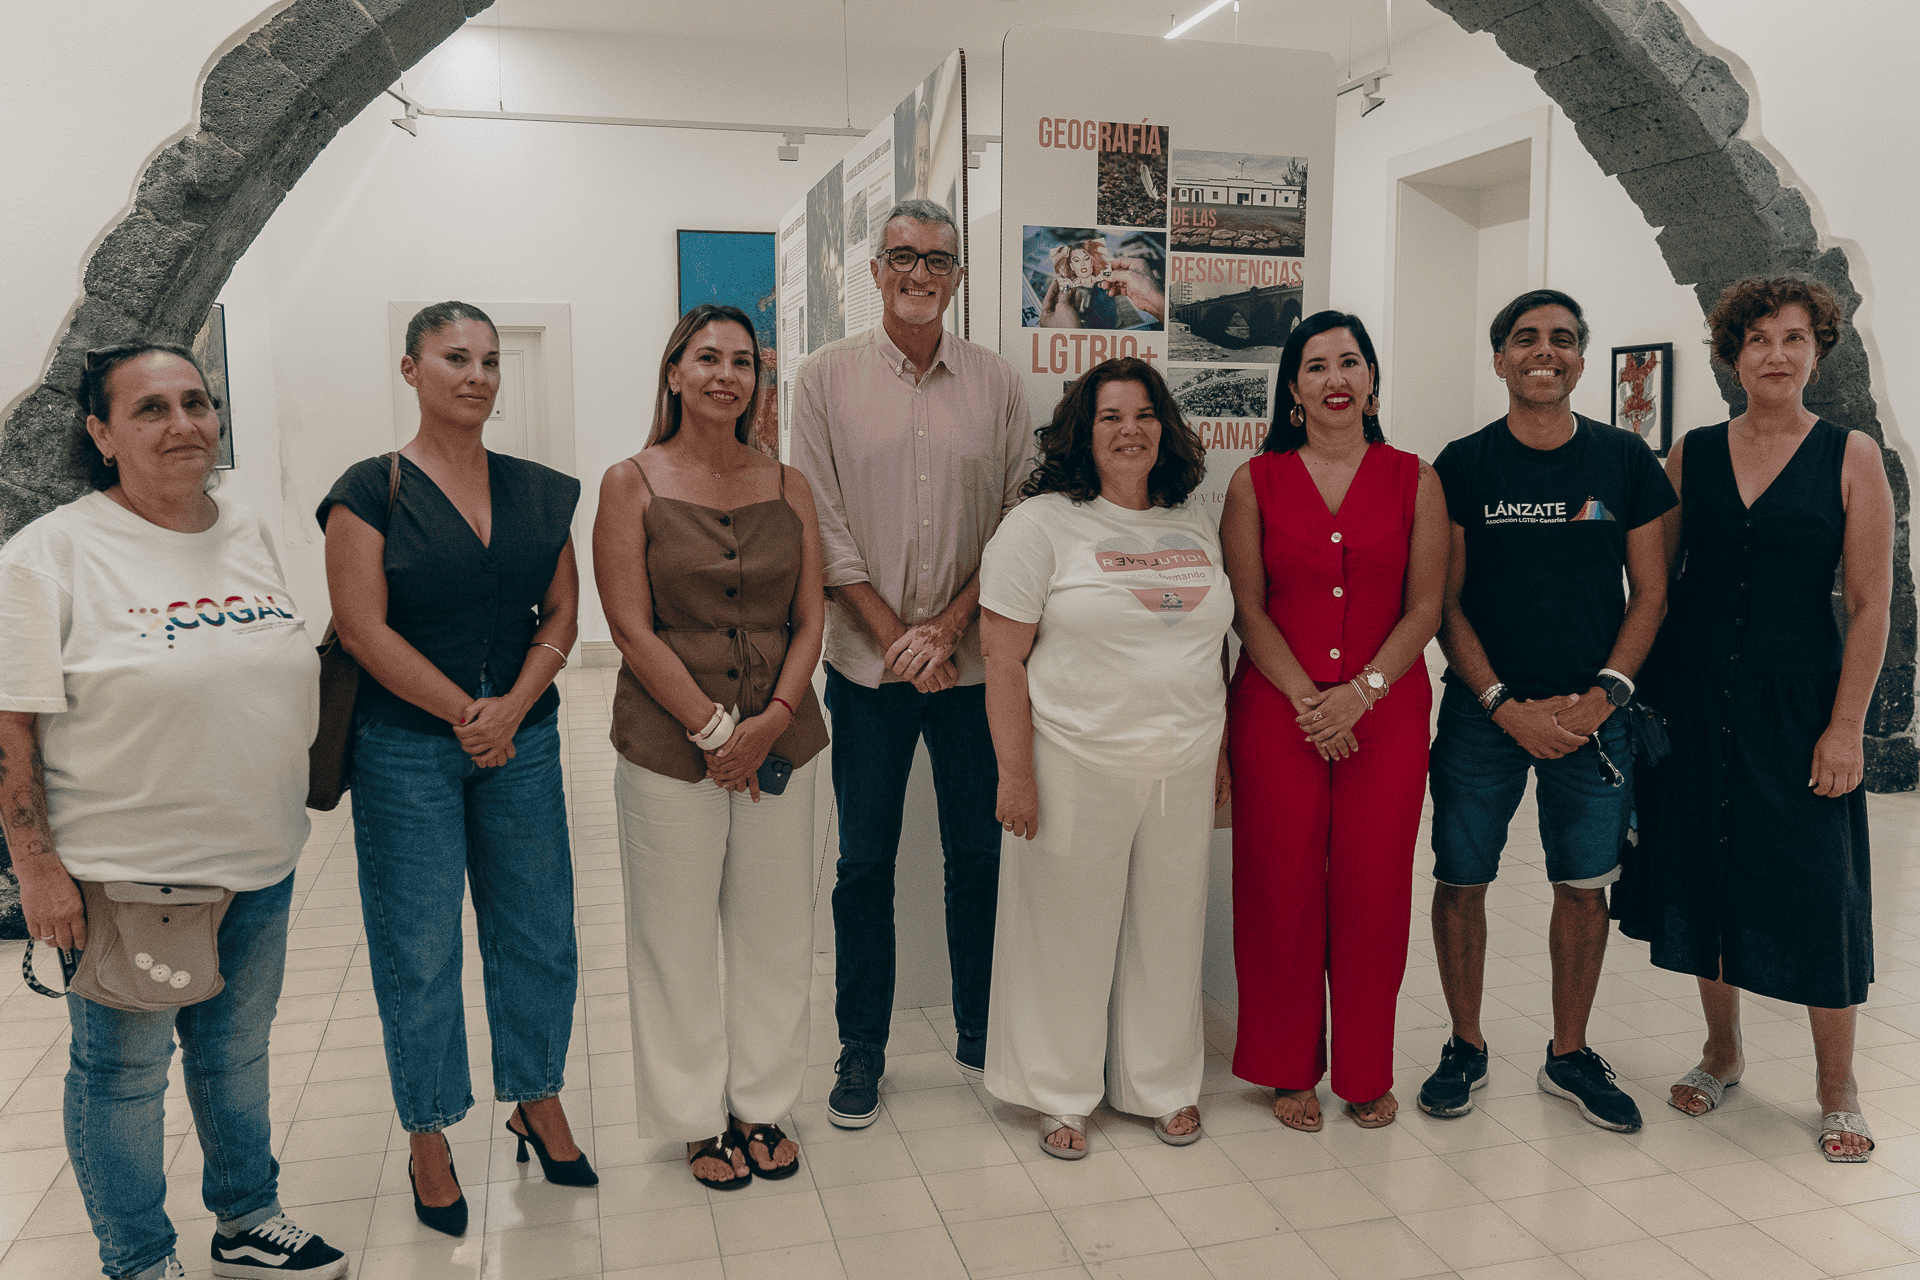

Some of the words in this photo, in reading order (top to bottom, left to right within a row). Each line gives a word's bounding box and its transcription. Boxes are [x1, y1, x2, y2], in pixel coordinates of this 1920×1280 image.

[1038, 117, 1162, 156] GEOGRAFÍA
[1172, 207, 1189, 225] DE
[1192, 208, 1217, 228] LAS
[1171, 256, 1303, 287] RESISTENCIAS
[1484, 501, 1566, 517] LÁNZATE
[1485, 517, 1518, 525] Asociación
[167, 596, 294, 629] COGAL
